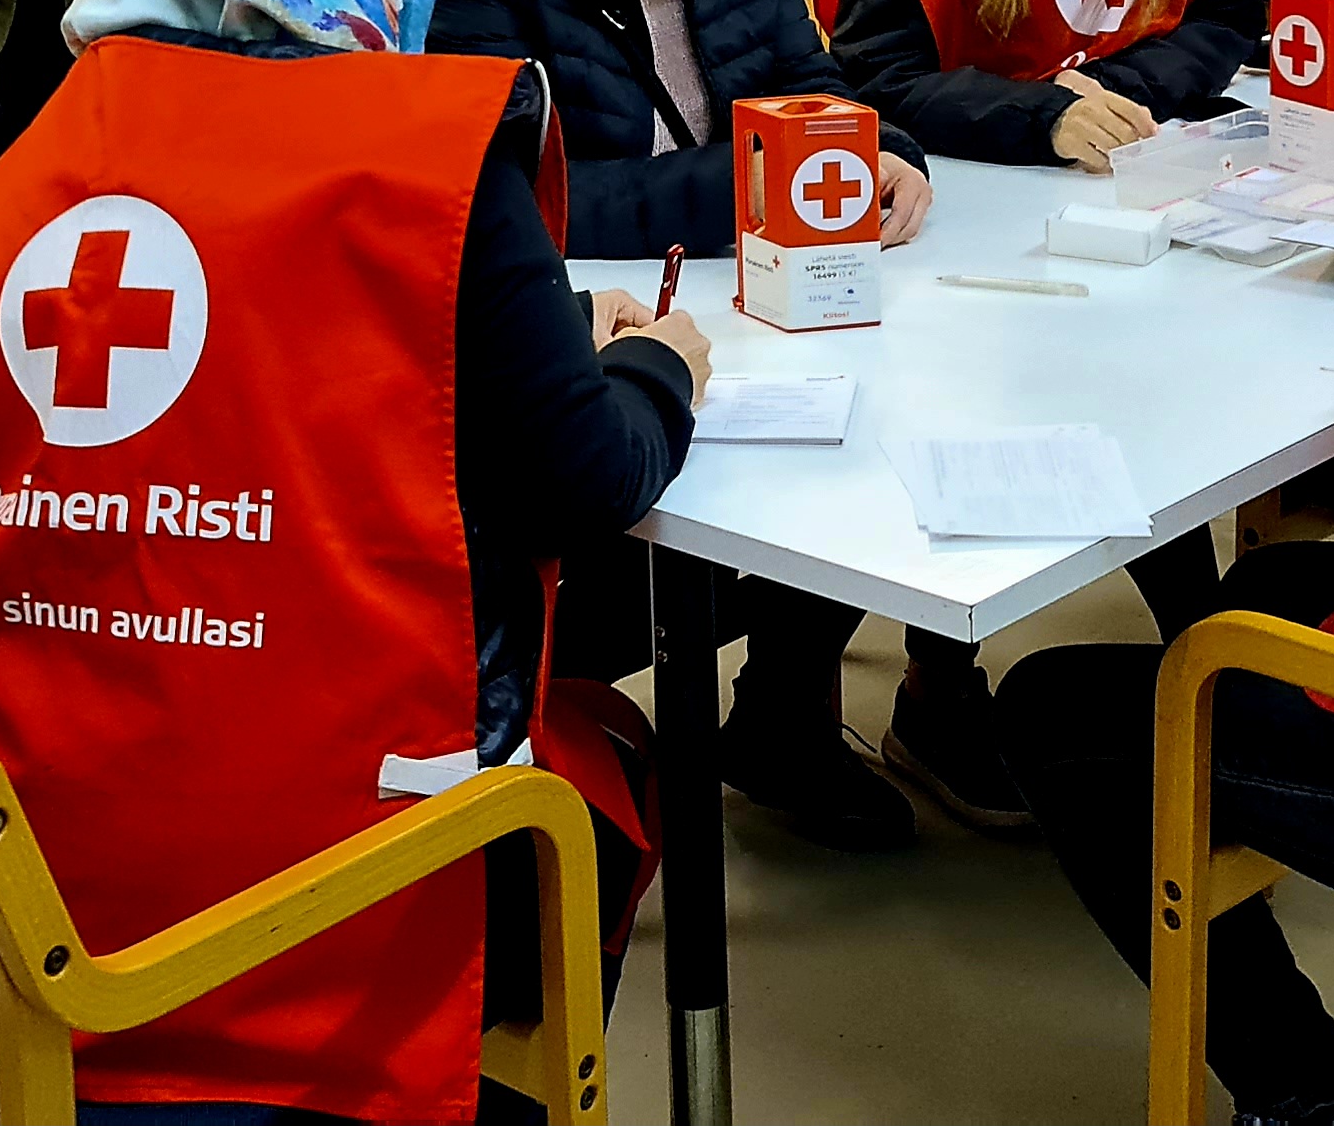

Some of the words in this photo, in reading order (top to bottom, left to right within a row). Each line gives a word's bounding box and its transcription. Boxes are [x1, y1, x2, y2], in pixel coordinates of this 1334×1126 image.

[145, 484, 274, 542] Risti
[2, 592, 100, 634] sinun
[110, 607, 265, 649] avullasi
